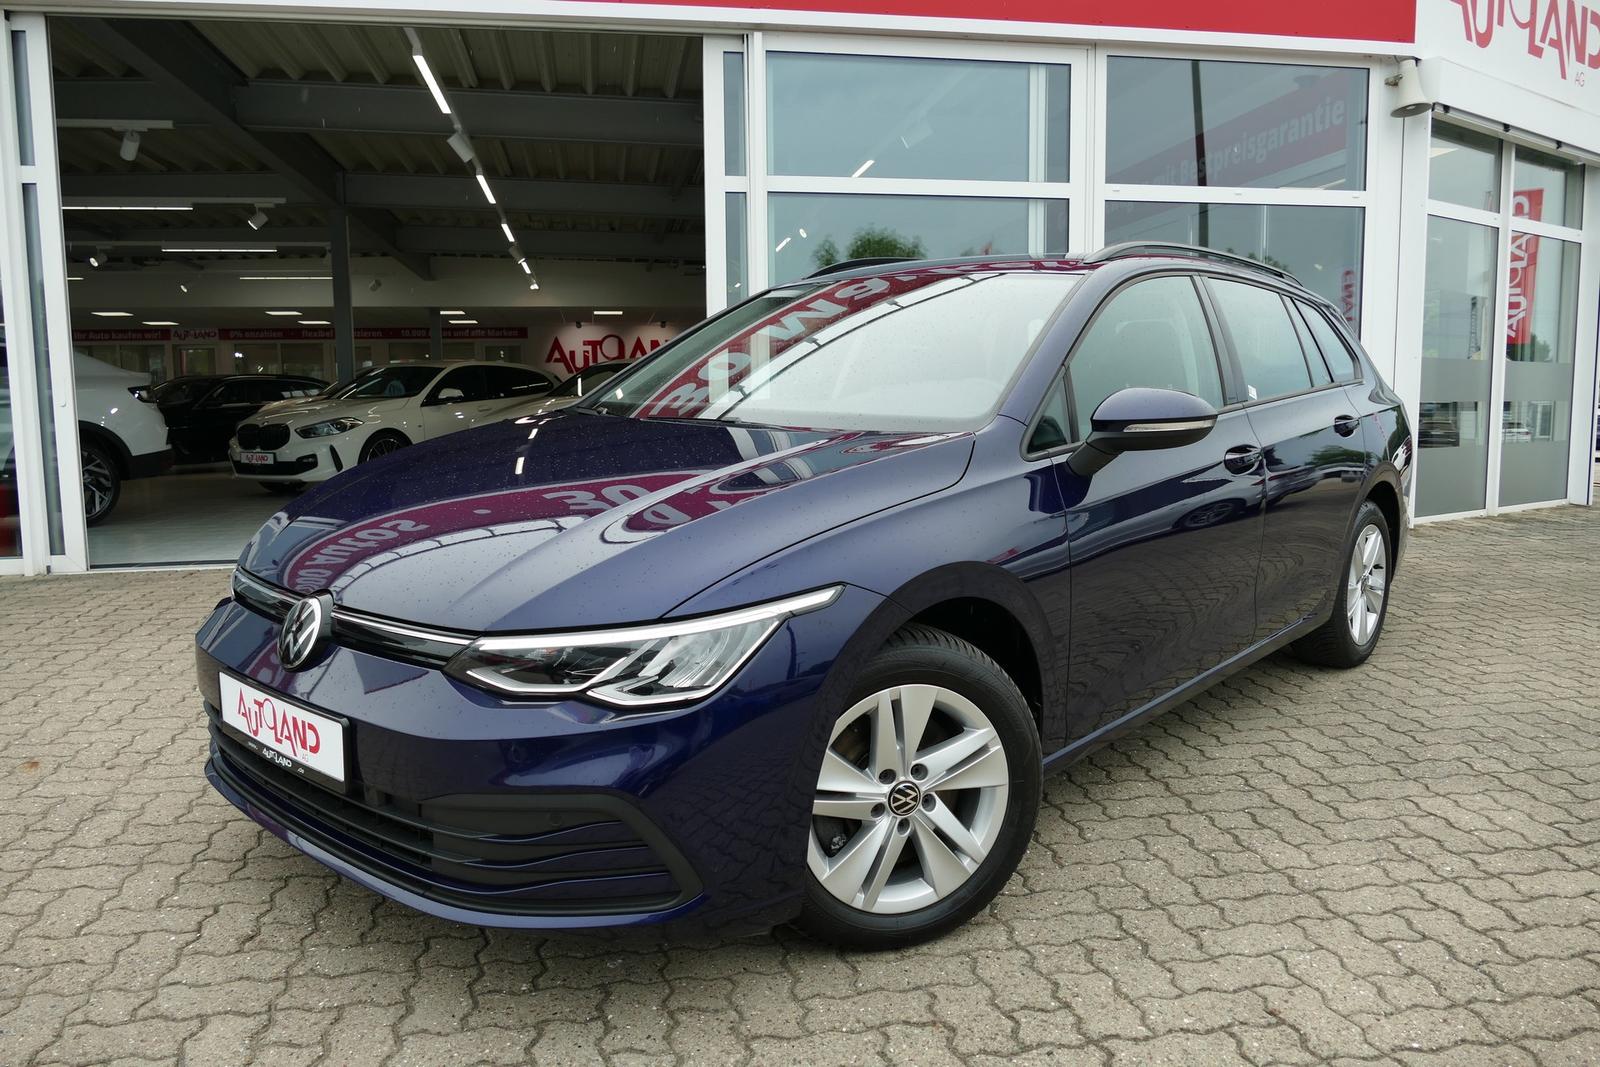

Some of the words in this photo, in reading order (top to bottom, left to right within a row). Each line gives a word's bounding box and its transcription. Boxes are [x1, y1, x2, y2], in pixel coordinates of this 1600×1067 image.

[1575, 71, 1585, 88] AG
[1180, 97, 1345, 184] Bestpreisgarantie
[1506, 195, 1531, 338] AUOLAD
[88, 331, 110, 340] Auto
[353, 330, 383, 338] zieren
[238, 686, 321, 758] AUTOLAND
[262, 747, 292, 768] AUTOLAND
